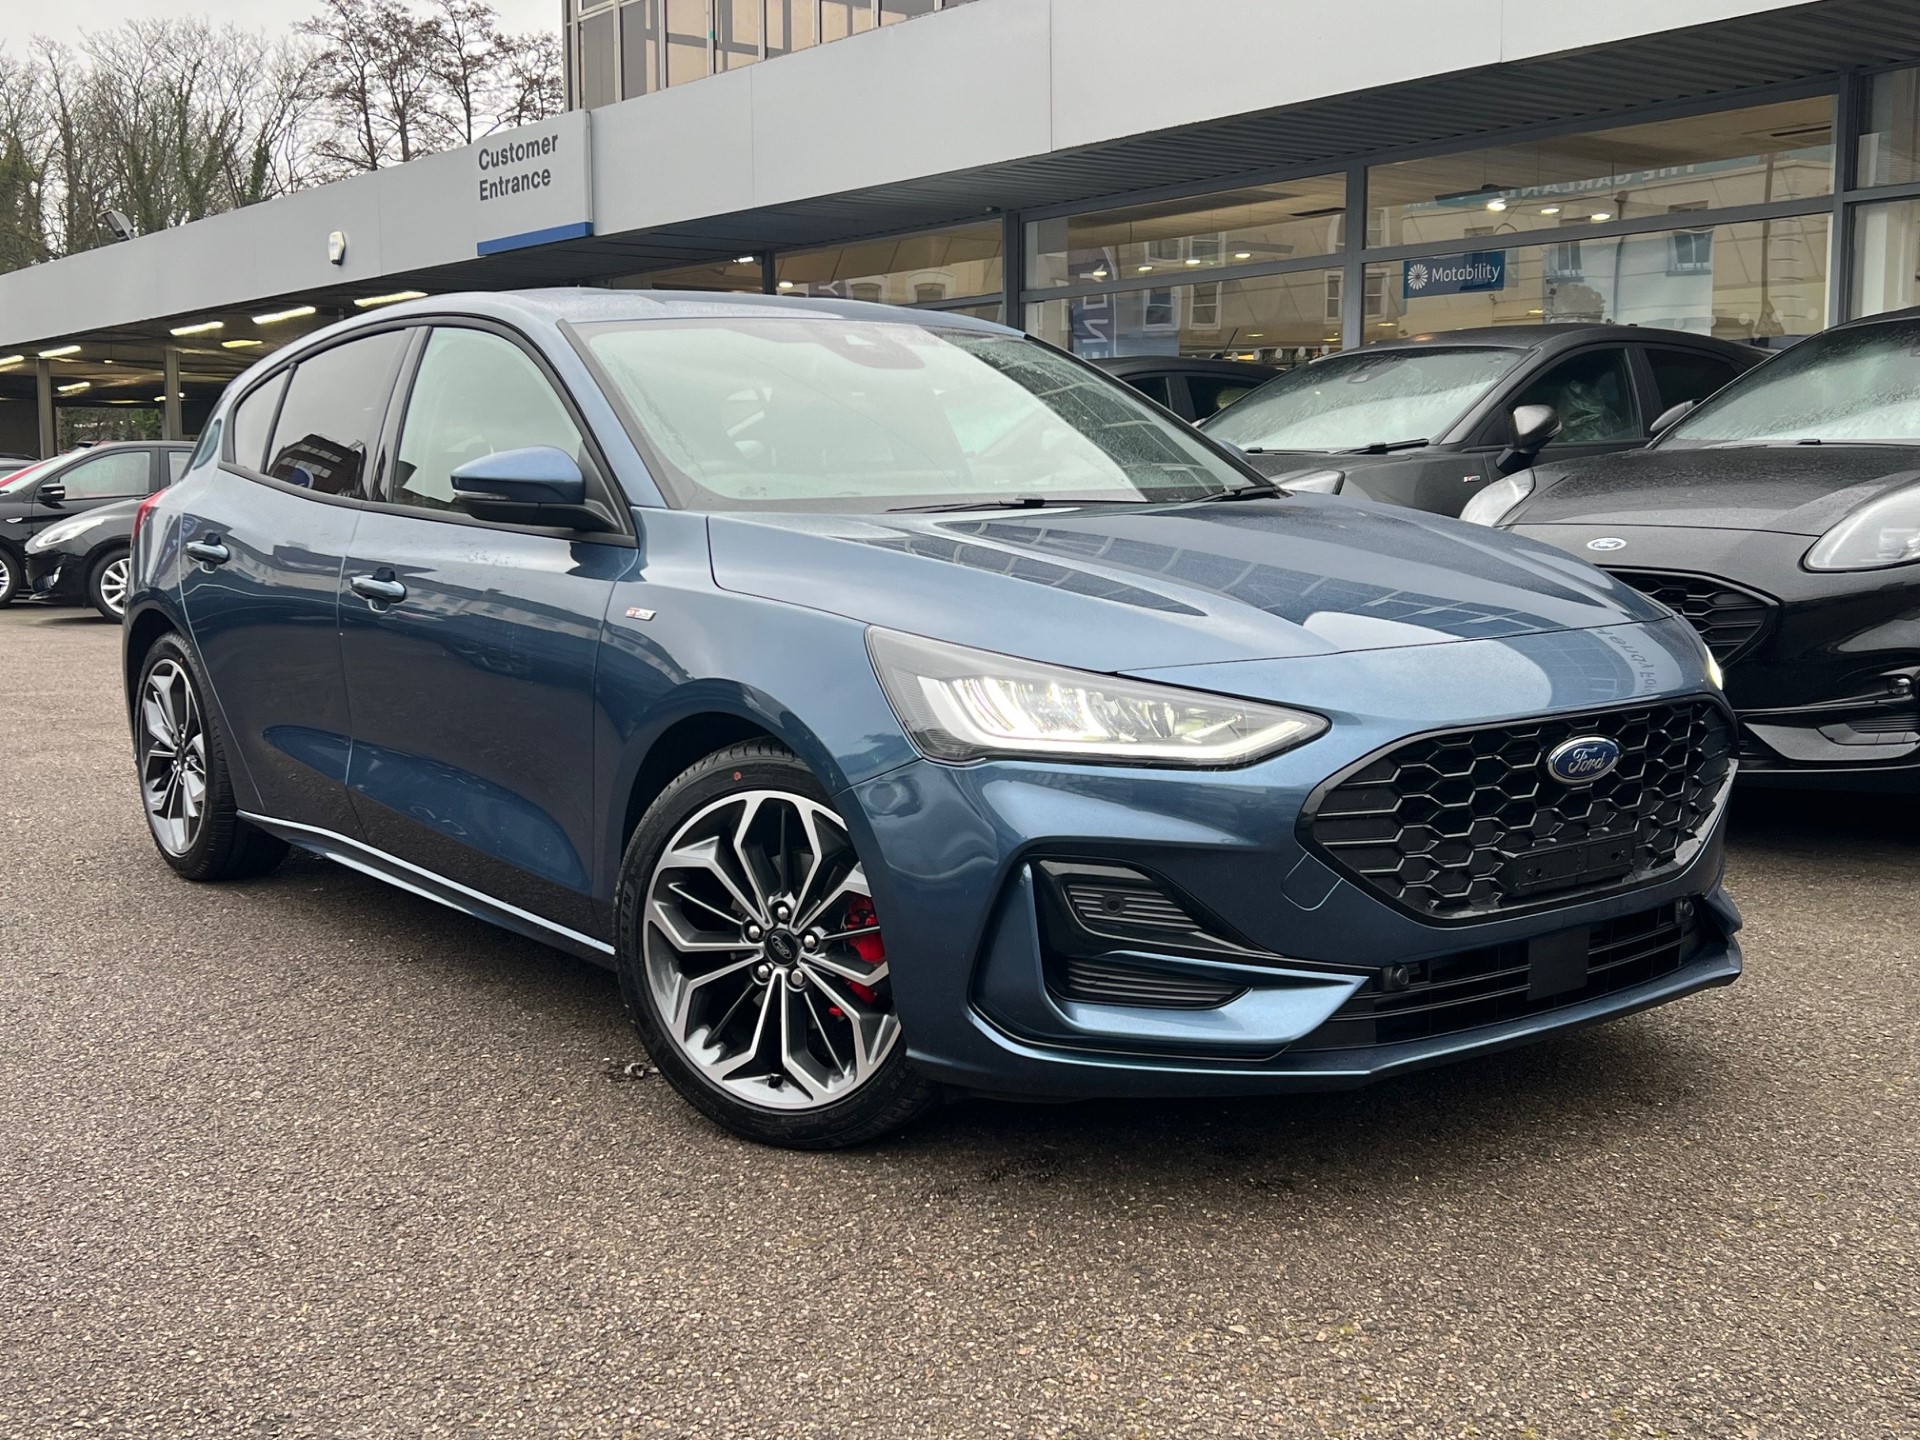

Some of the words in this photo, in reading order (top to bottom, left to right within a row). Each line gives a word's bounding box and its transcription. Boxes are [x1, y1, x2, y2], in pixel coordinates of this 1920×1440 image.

[478, 134, 559, 170] Customer
[479, 168, 551, 201] Entrance
[1431, 263, 1501, 283] Motability
[1567, 747, 1607, 774] Ford
